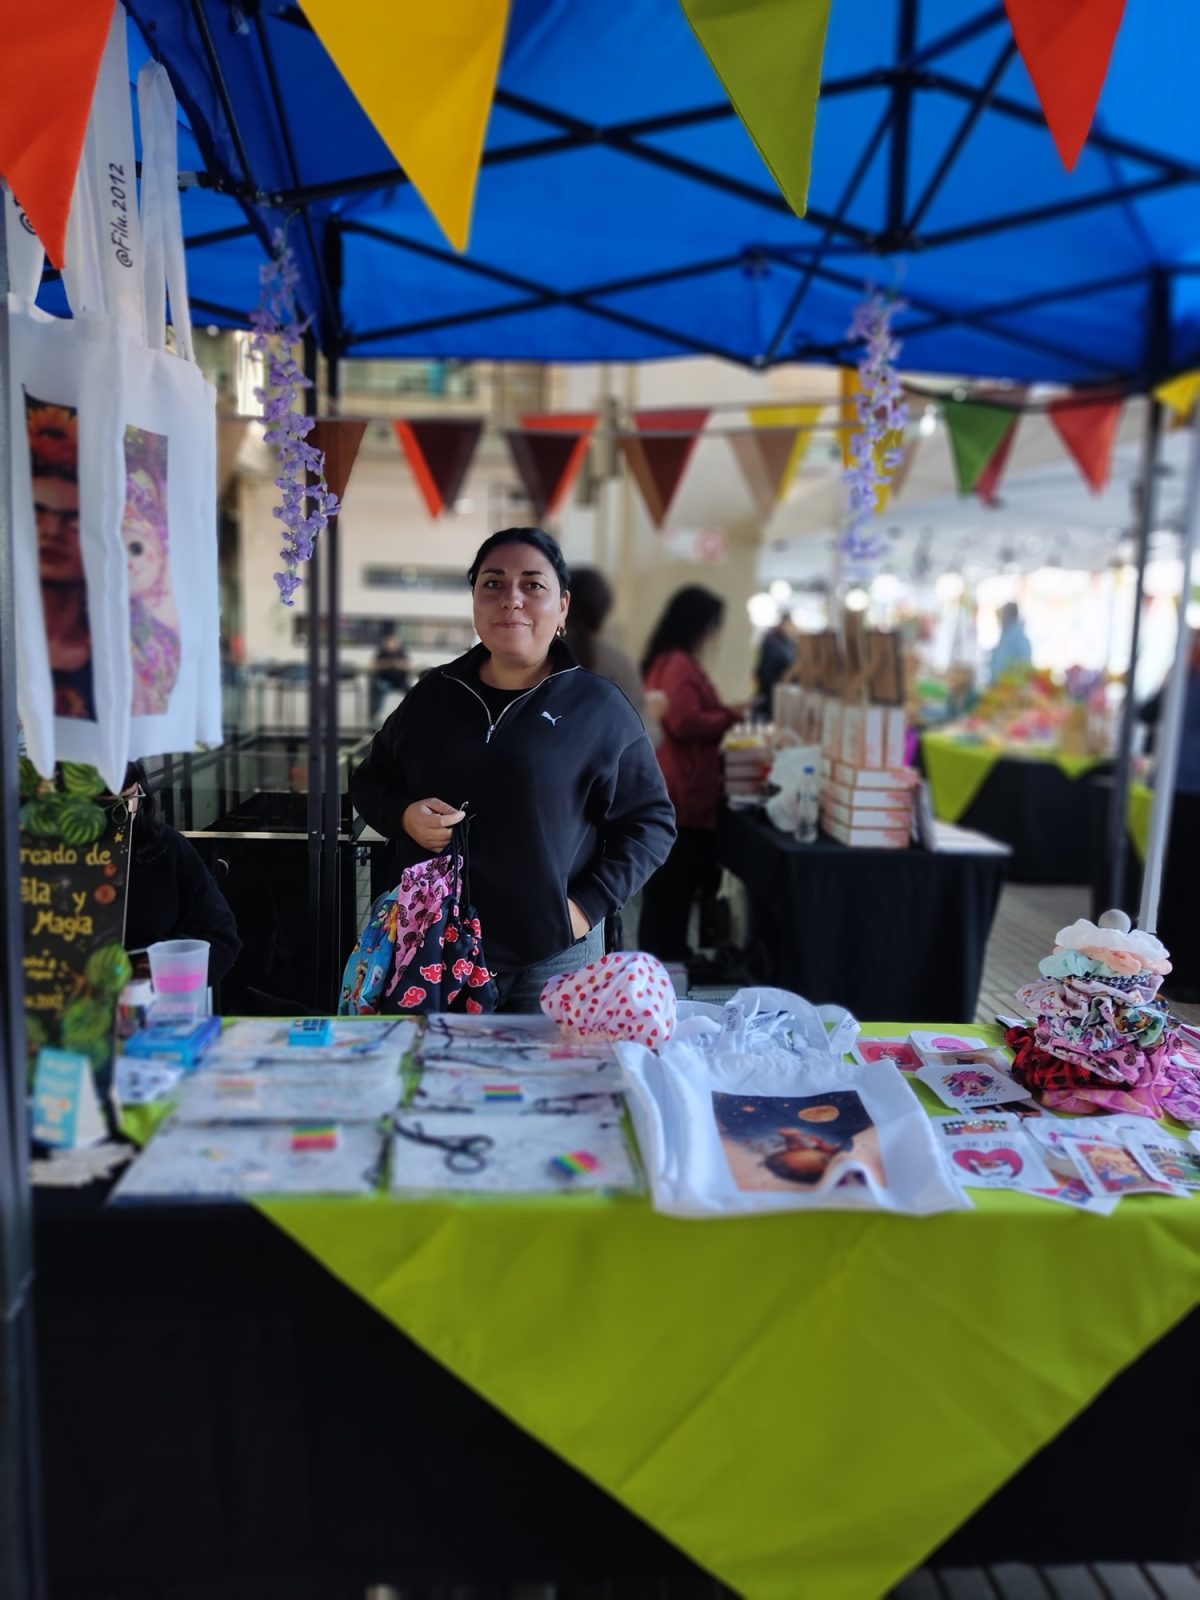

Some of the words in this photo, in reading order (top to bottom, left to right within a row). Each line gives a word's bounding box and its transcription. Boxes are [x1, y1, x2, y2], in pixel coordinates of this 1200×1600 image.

[108, 163, 133, 268] @Filu.2012
[20, 843, 77, 865] rcado
[85, 842, 112, 866] de
[71, 890, 86, 913] y
[32, 910, 92, 941] Magia
